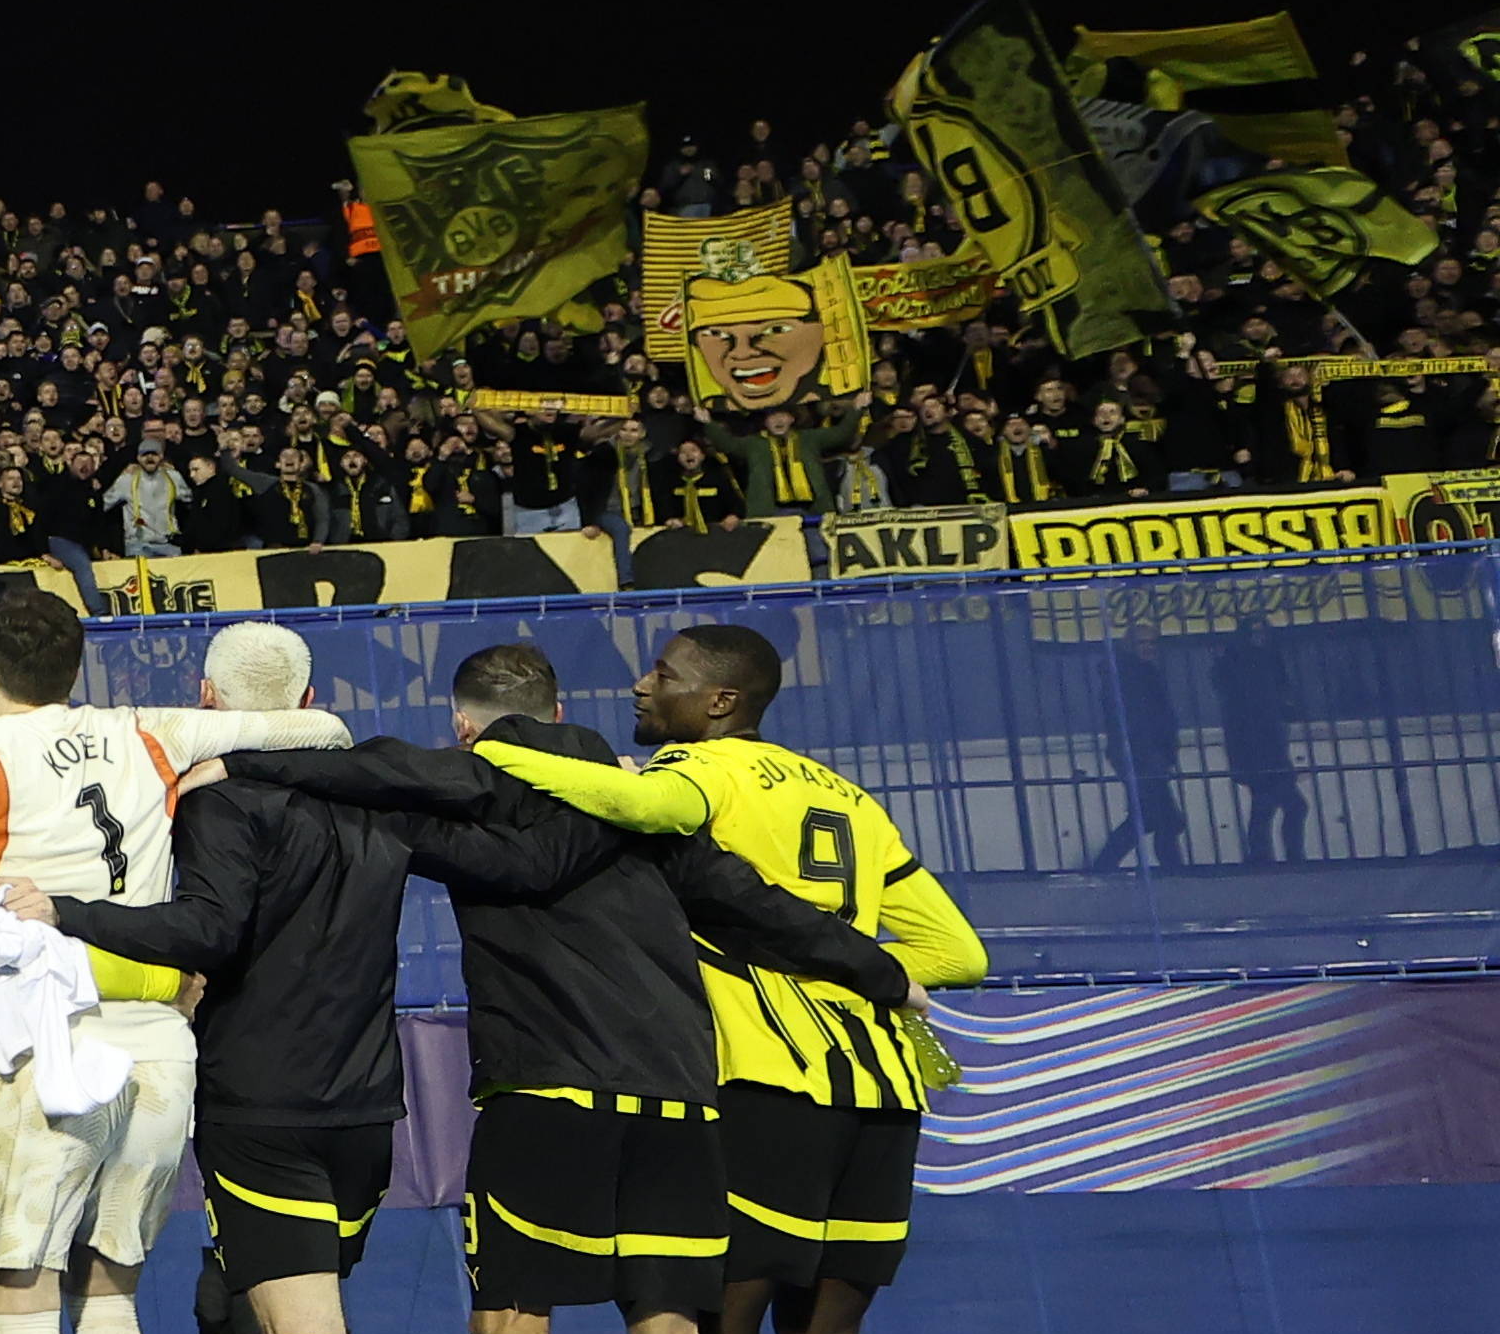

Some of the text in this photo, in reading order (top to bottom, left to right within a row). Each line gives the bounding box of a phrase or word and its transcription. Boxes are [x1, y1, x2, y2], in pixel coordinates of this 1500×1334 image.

[837, 523, 1000, 576] AKLP
[1038, 501, 1384, 575] BORUSSIA
[75, 781, 128, 896] 1
[798, 805, 858, 925] 9
